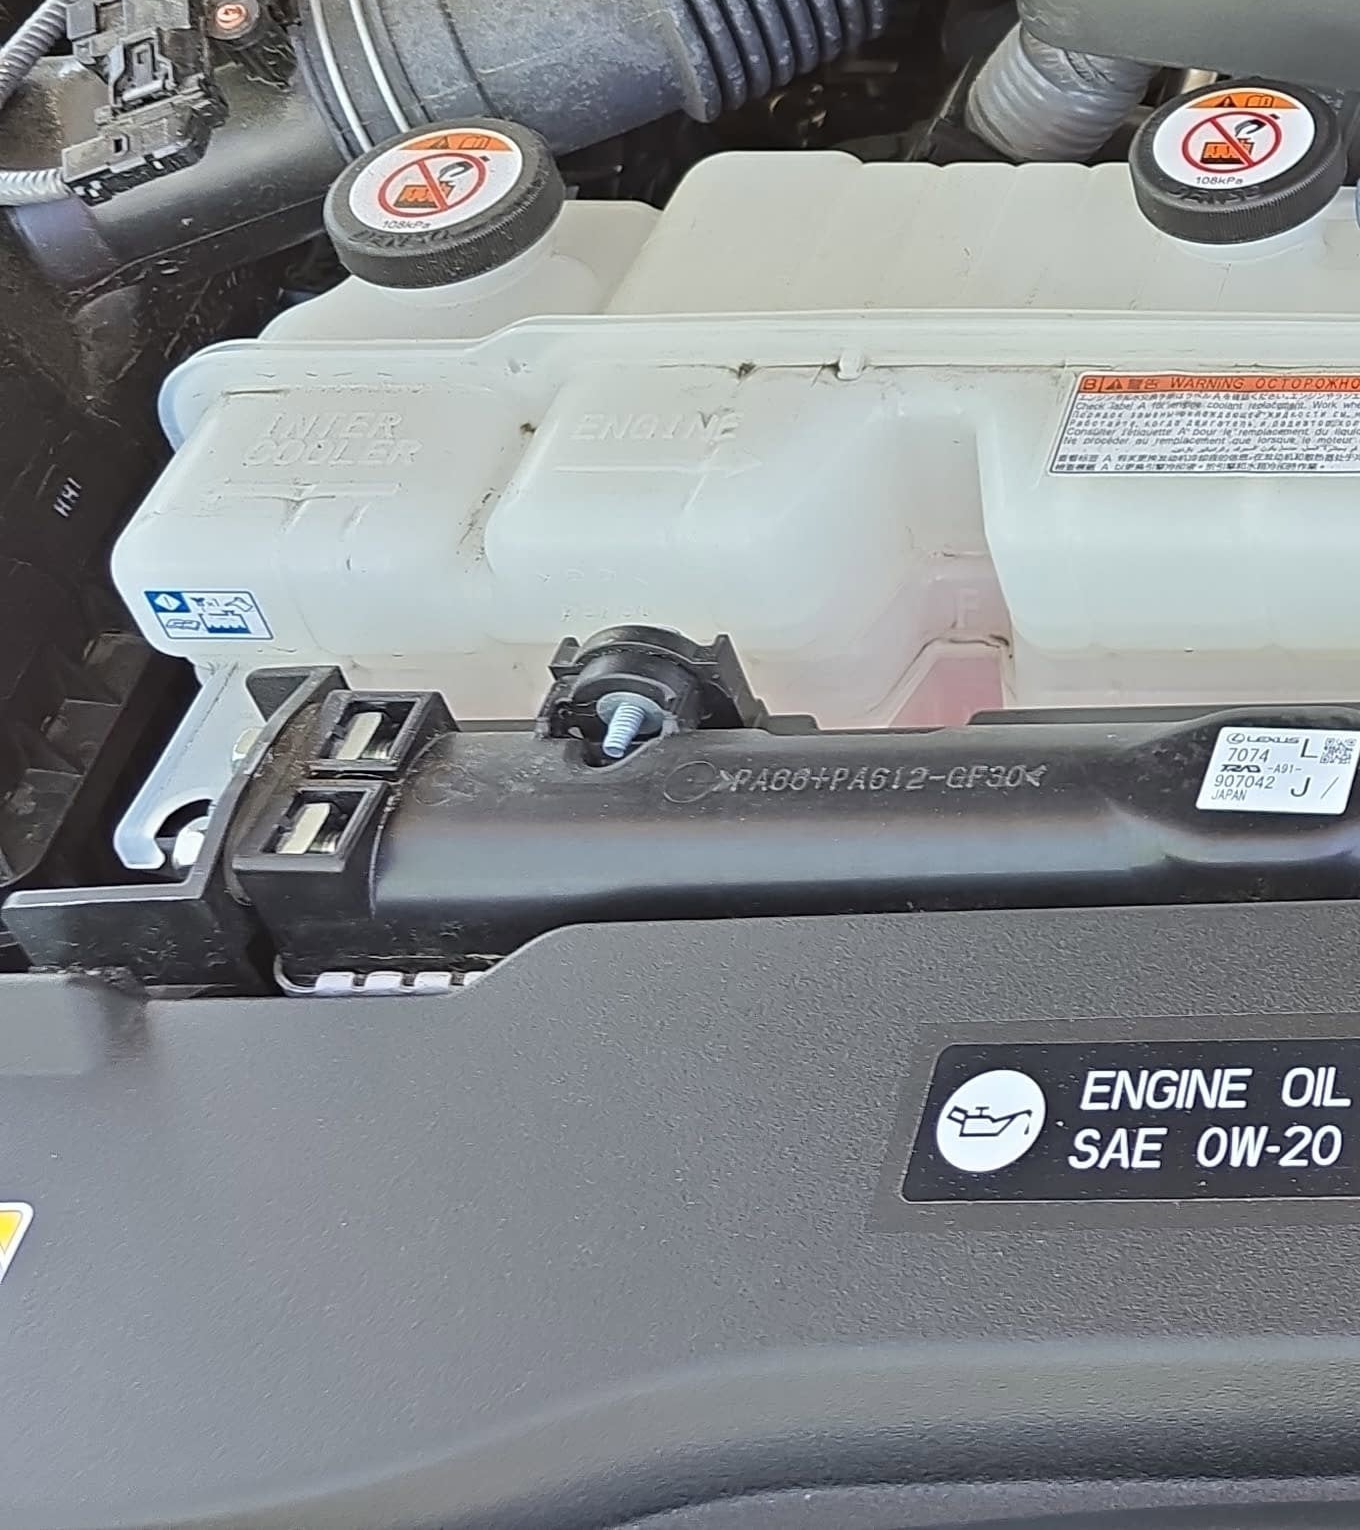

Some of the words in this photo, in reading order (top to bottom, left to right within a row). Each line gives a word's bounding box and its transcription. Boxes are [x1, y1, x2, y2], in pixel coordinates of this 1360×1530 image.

[1083, 379, 1096, 390] B
[1171, 377, 1245, 390] WARNING
[1255, 378, 1360, 390] ОСТОРОЖНО
[1076, 402, 1104, 410] Check
[1313, 401, 1337, 409] Work
[1193, 428, 1217, 437] pour
[1247, 735, 1301, 744] LEXUS
[1300, 739, 1318, 759] L
[1228, 748, 1270, 763] 7074
[1267, 764, 1302, 774] -A91-
[1214, 775, 1275, 789] 907042
[1291, 777, 1311, 798] J
[1211, 789, 1247, 801] JAPAN
[1080, 1067, 1253, 1111] ENGINE
[1281, 1066, 1352, 1109] OIL
[1068, 1128, 1168, 1170] SAE
[1197, 1125, 1342, 1168] 0W-20
